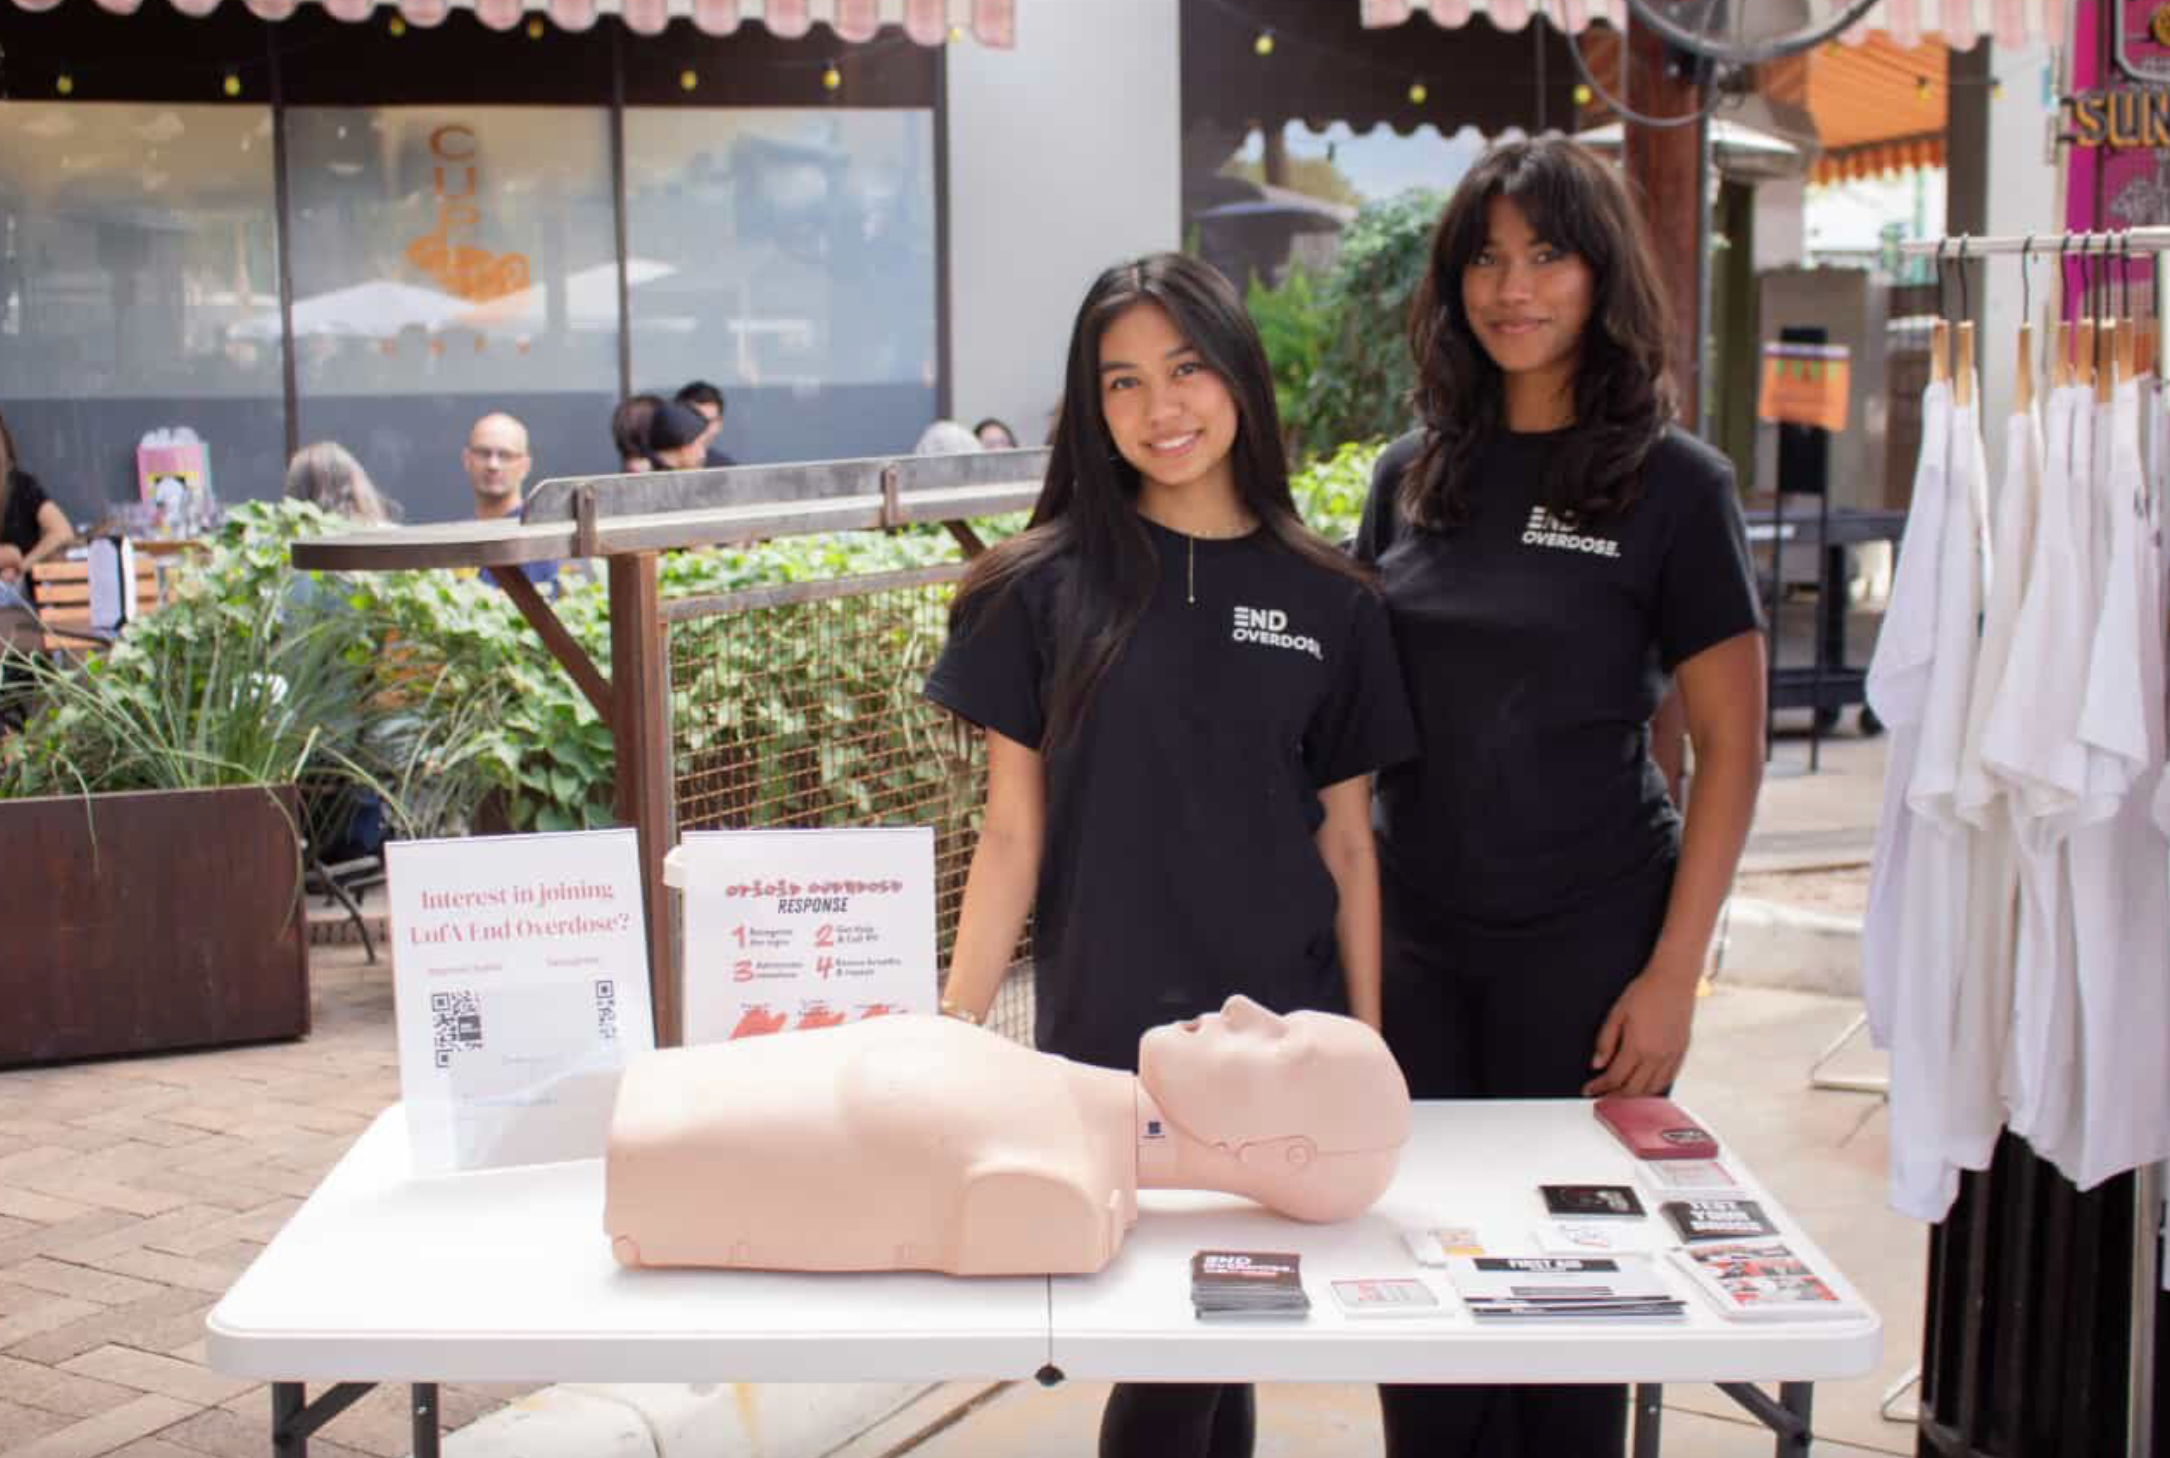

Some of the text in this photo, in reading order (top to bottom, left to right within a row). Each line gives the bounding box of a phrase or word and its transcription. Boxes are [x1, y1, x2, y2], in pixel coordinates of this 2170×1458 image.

[1522, 530, 1622, 558] OVERDOSE.
[1233, 606, 1288, 631] END
[421, 880, 614, 909] Interest in joining
[777, 896, 849, 914] RESPONSE
[468, 915, 511, 942] End
[517, 911, 630, 938] Overdose?
[731, 924, 746, 949] 1
[813, 923, 834, 948] 2
[733, 958, 755, 983] 3
[815, 955, 834, 981] 4
